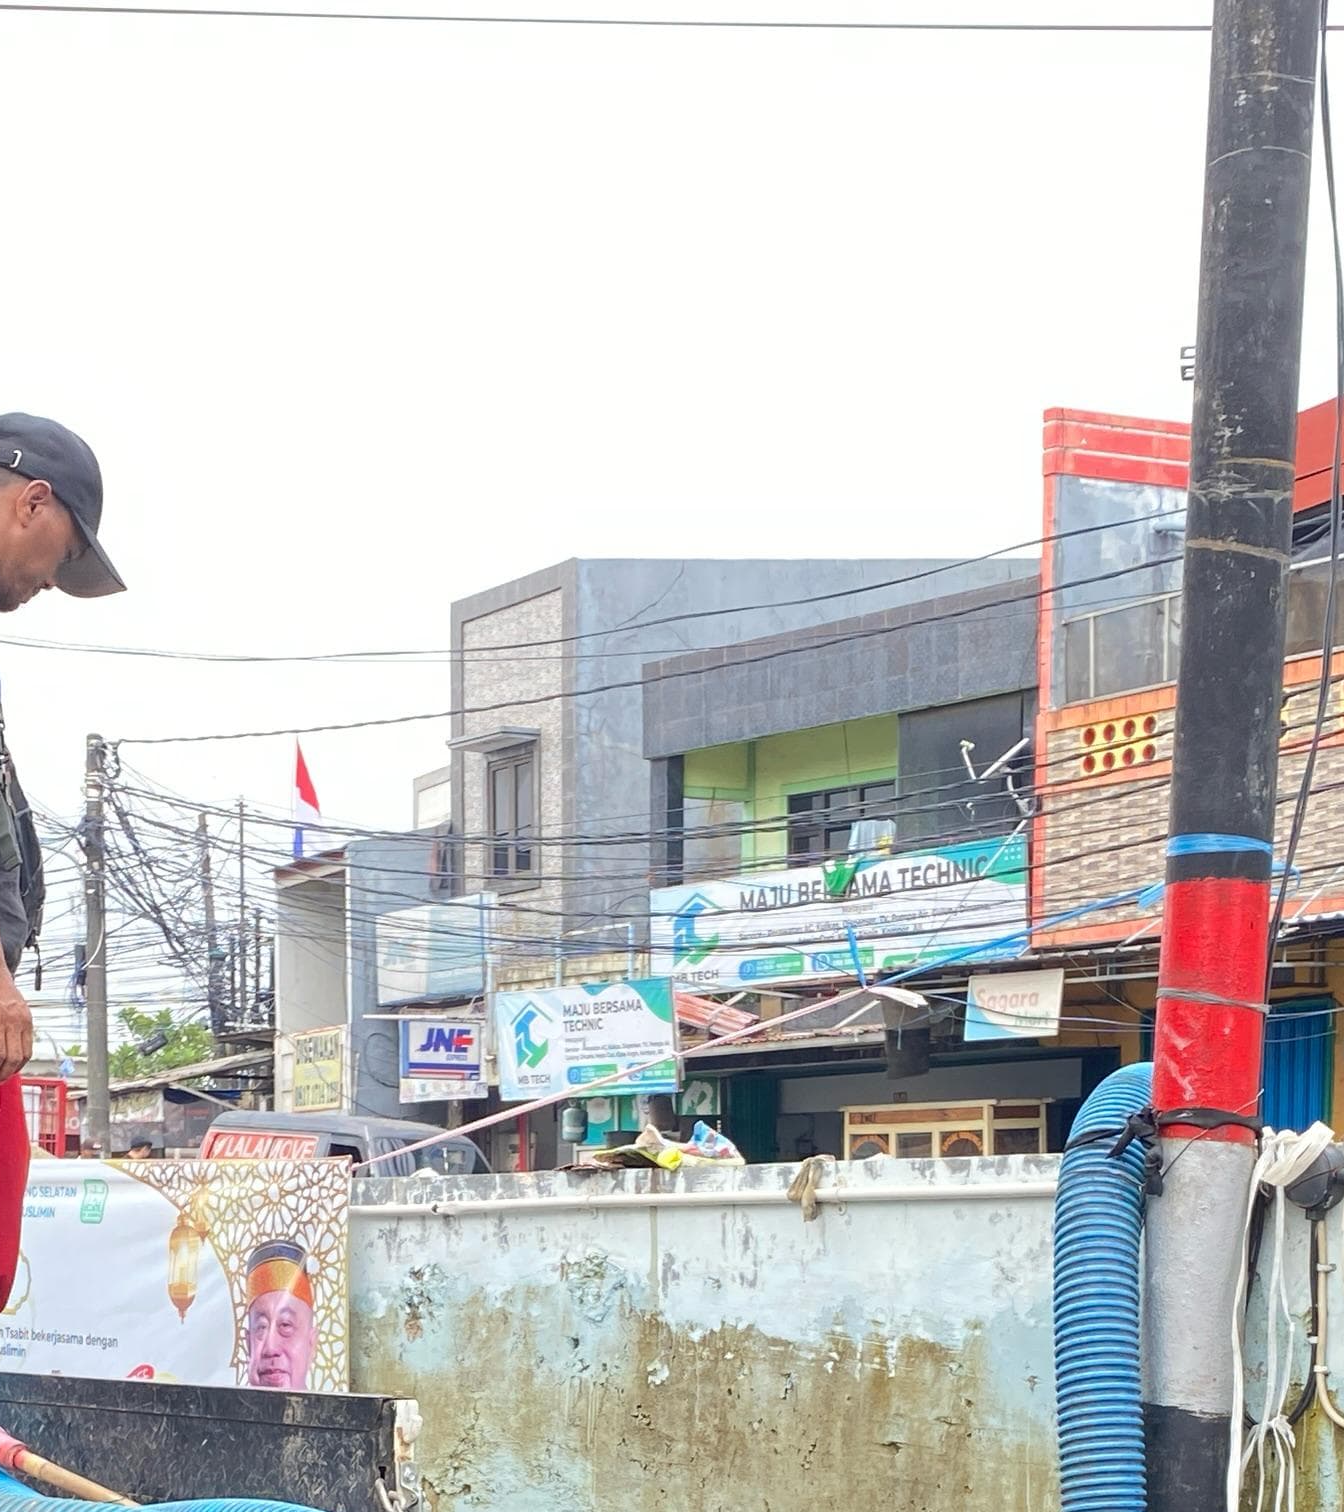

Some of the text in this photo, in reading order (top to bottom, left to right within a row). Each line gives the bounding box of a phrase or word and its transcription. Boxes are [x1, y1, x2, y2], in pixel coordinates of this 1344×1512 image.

[740, 855, 989, 912] MAJU BEAMA TECHNIC
[692, 969, 720, 982] TECH
[563, 998, 643, 1017] MAJU BERSAMA
[977, 988, 1039, 1011] Sagara
[563, 1018, 604, 1033] TECHNIC
[419, 1028, 474, 1053] JNE
[529, 1074, 551, 1084] TECH
[40, 1186, 77, 1198] SELATAN
[5, 1327, 29, 1340] Tsabit
[30, 1329, 84, 1346] bekerjasama
[85, 1334, 119, 1350] dengan
